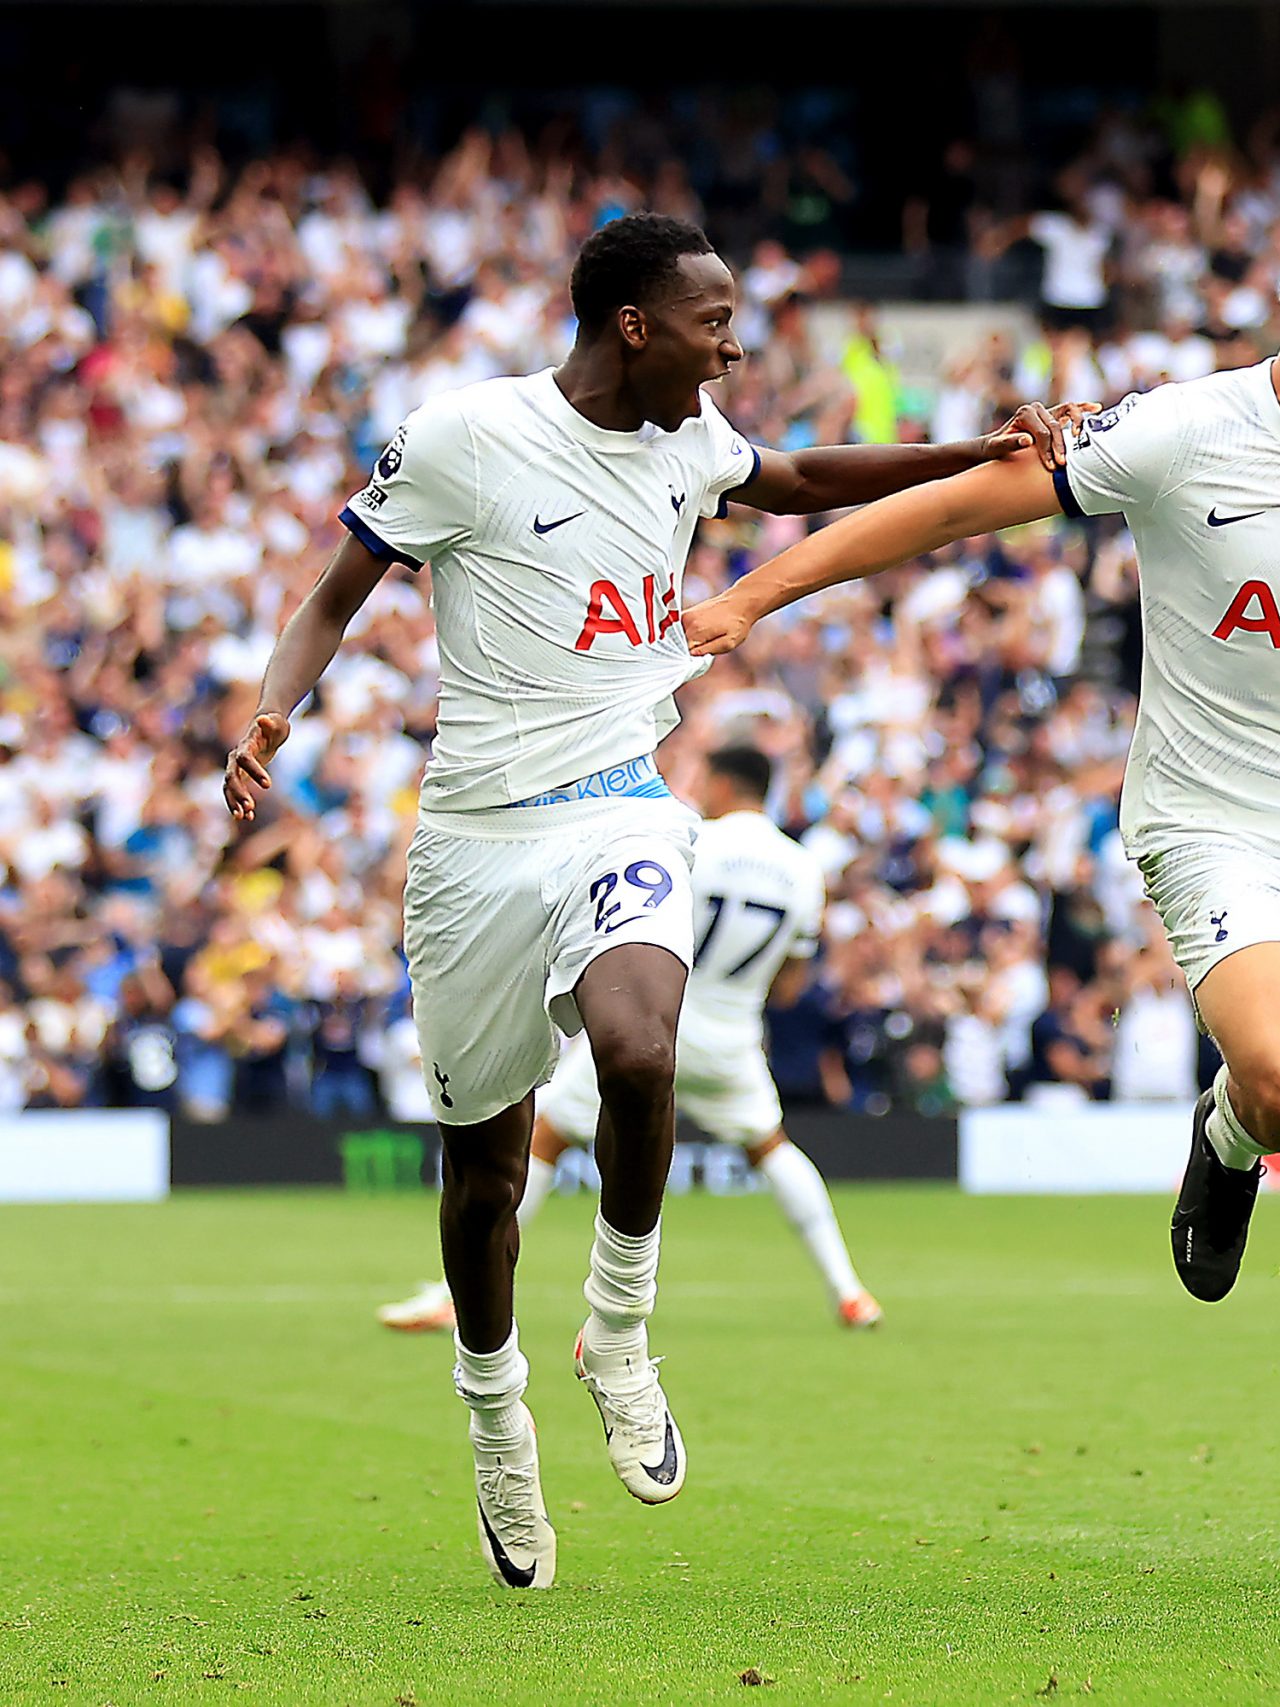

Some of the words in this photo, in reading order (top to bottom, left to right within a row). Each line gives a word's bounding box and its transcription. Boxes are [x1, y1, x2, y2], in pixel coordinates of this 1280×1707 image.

[576, 755, 653, 800] Klein
[589, 859, 673, 932] 29
[693, 895, 786, 977] 17
